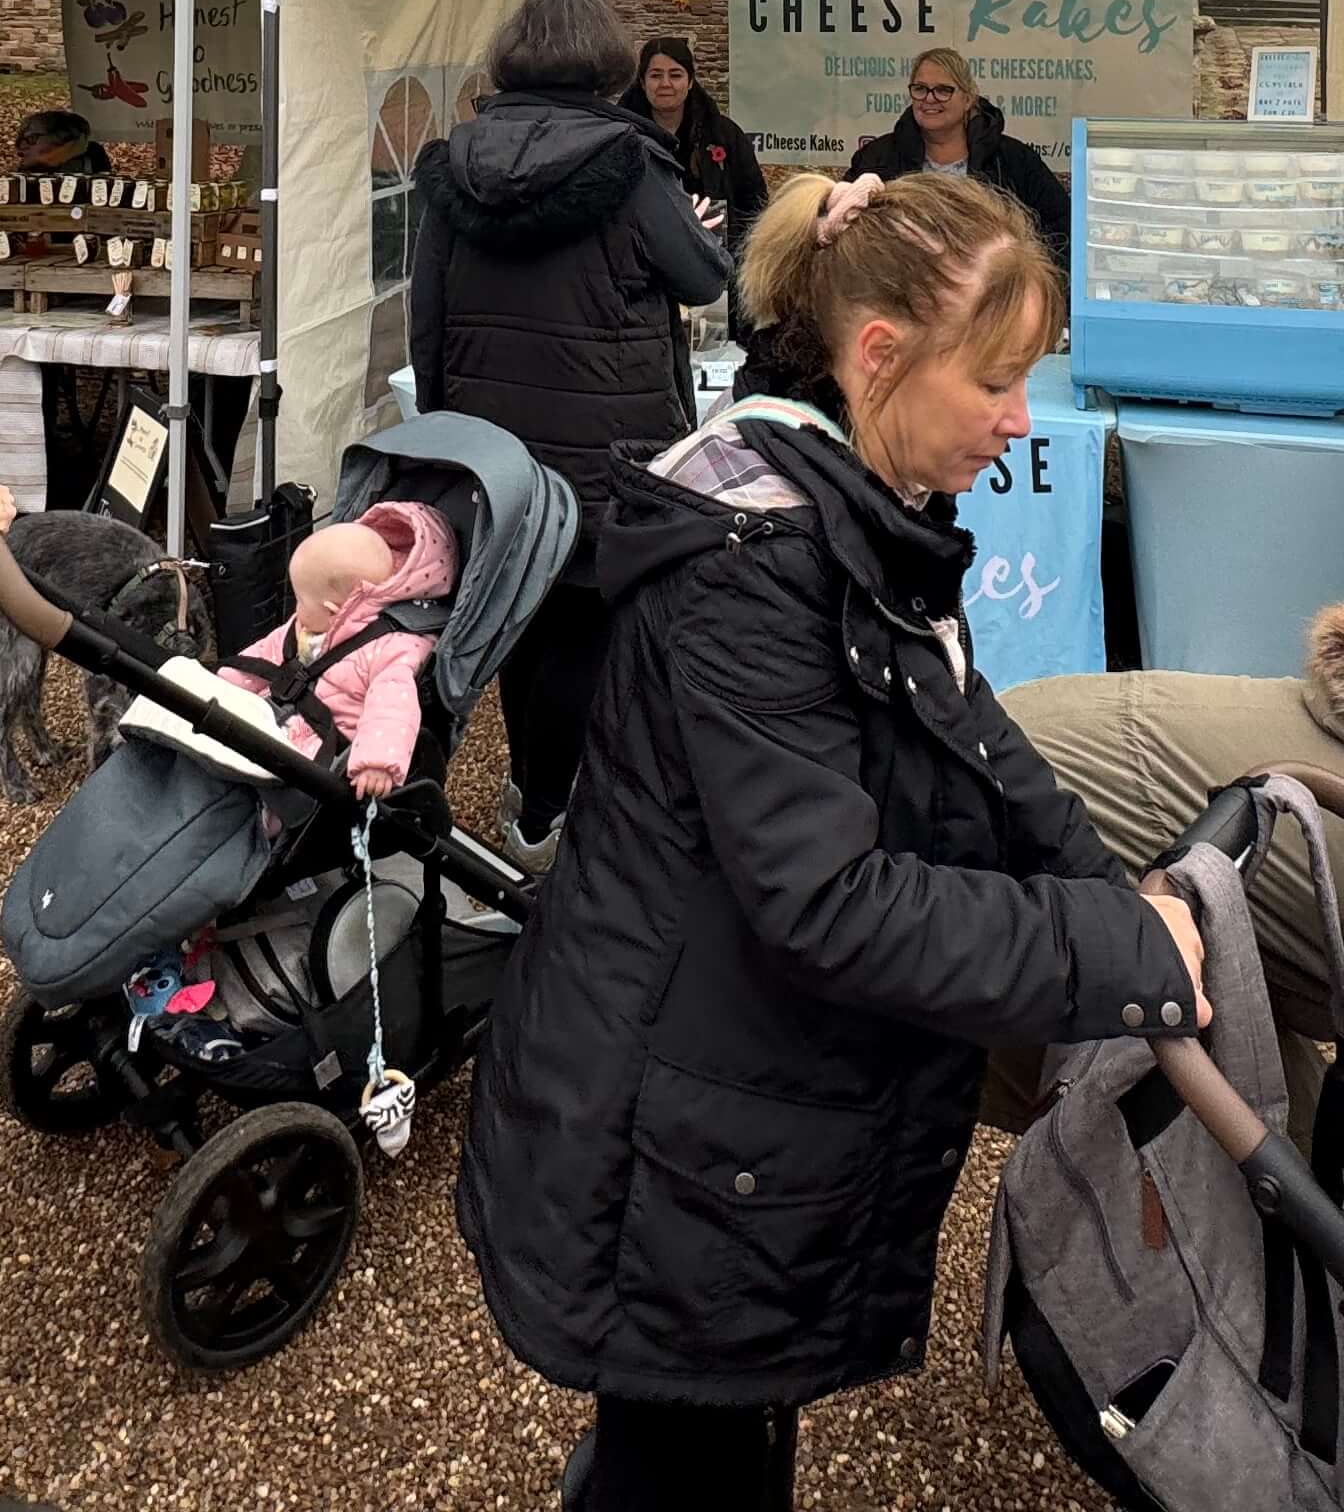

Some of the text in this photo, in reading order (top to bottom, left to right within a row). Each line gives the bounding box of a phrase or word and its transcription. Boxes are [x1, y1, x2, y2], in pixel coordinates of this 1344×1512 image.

[824, 55, 896, 78] DELICIOUS
[990, 57, 1098, 83] CHEESECAKES,
[156, 67, 258, 104] Godness
[1011, 95, 1057, 117] MORE!
[765, 133, 806, 151] Cheese
[809, 134, 845, 152] Kakes
